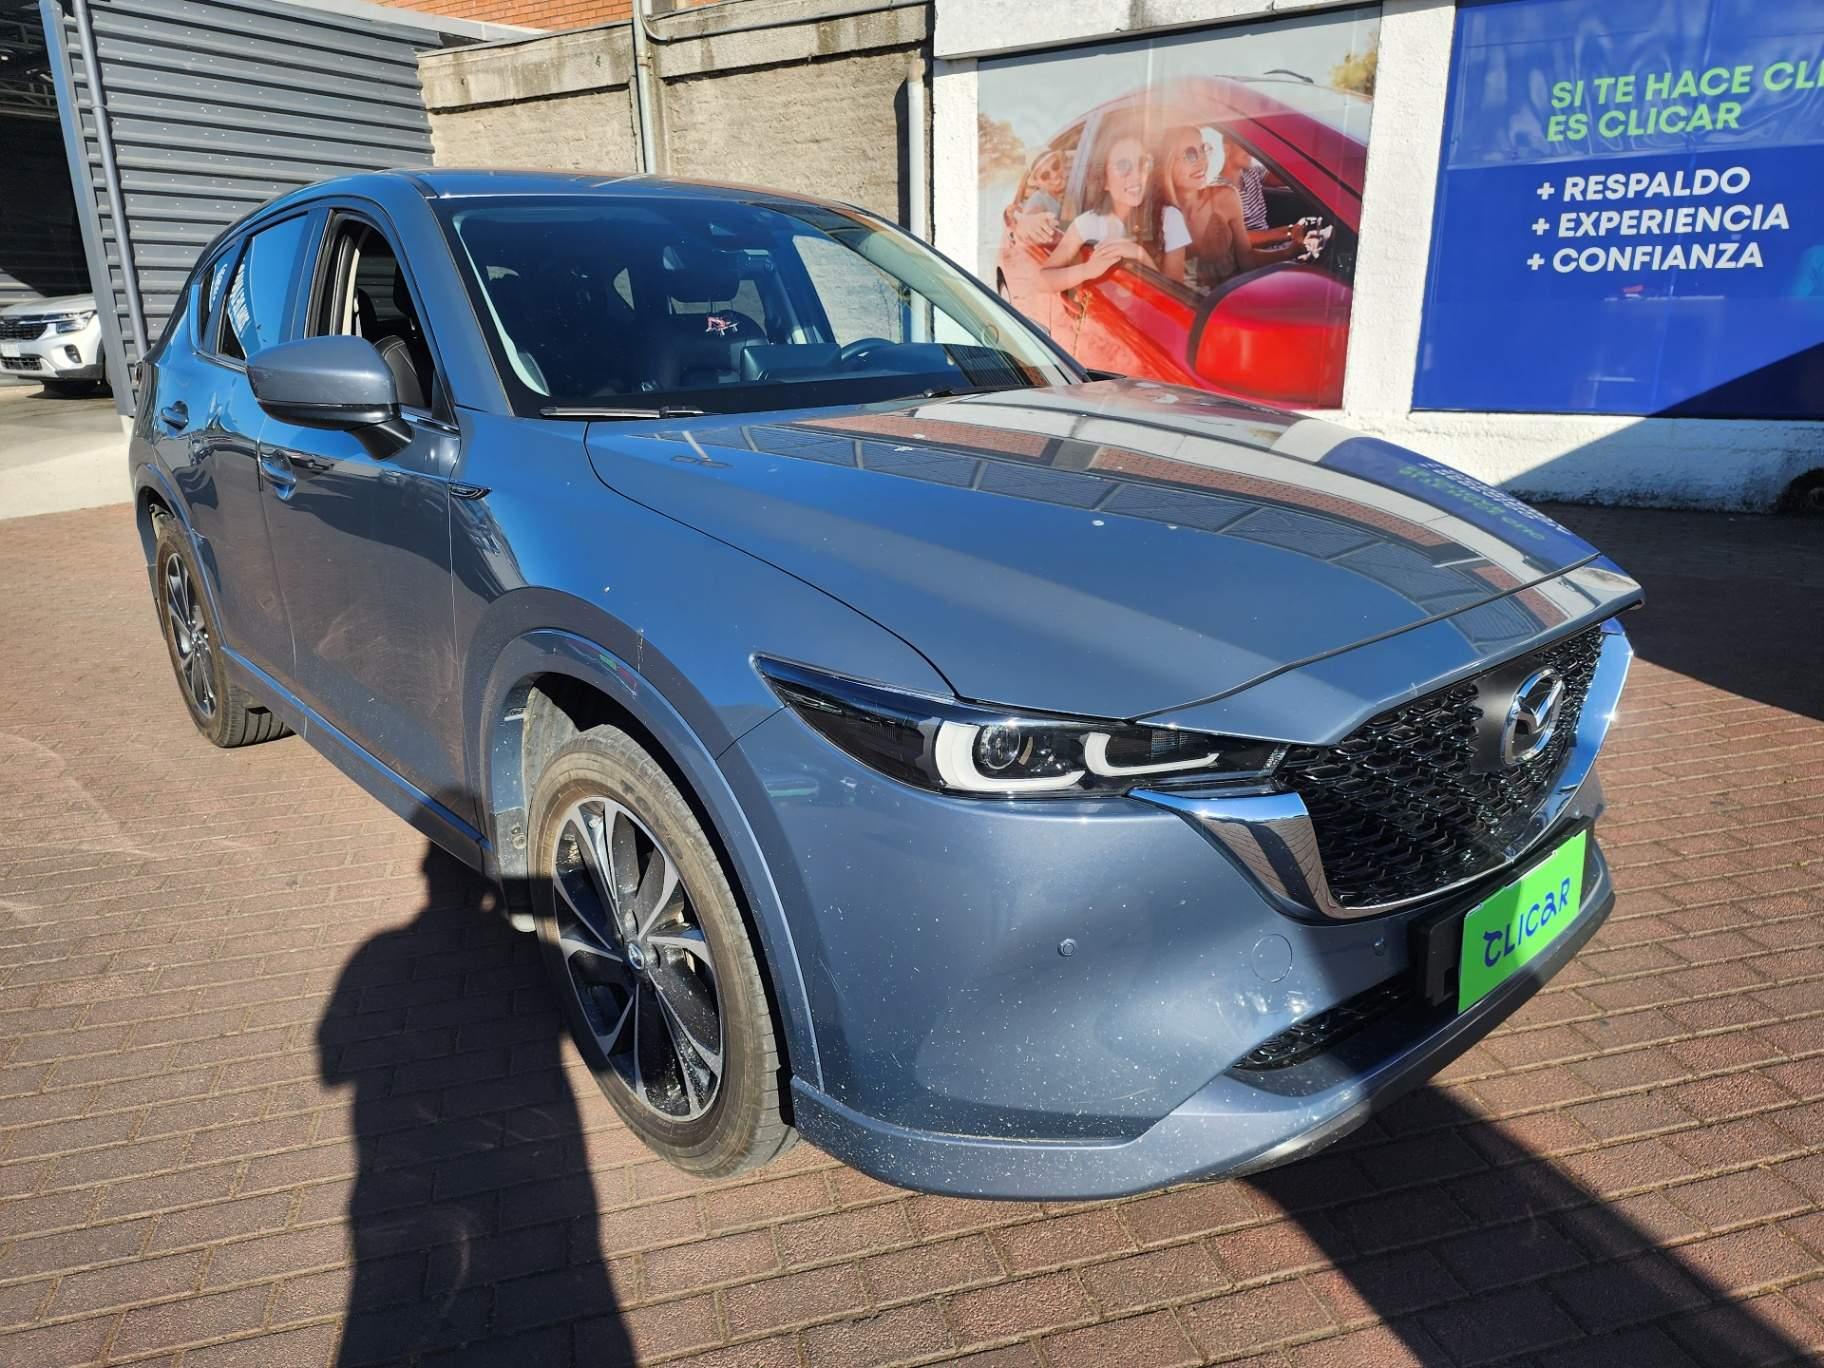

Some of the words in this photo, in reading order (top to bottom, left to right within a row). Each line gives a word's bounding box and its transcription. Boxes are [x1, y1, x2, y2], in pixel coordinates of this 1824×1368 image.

[1551, 81, 1585, 109] SI
[1593, 75, 1636, 104] TE
[1644, 65, 1754, 102] HACE
[1546, 113, 1589, 142] ES
[1598, 102, 1743, 139] CLICAR
[1563, 166, 1751, 202] RESPALDO
[1558, 203, 1790, 238] EXPERIENCIA
[1552, 241, 1764, 274] CONFIANZA
